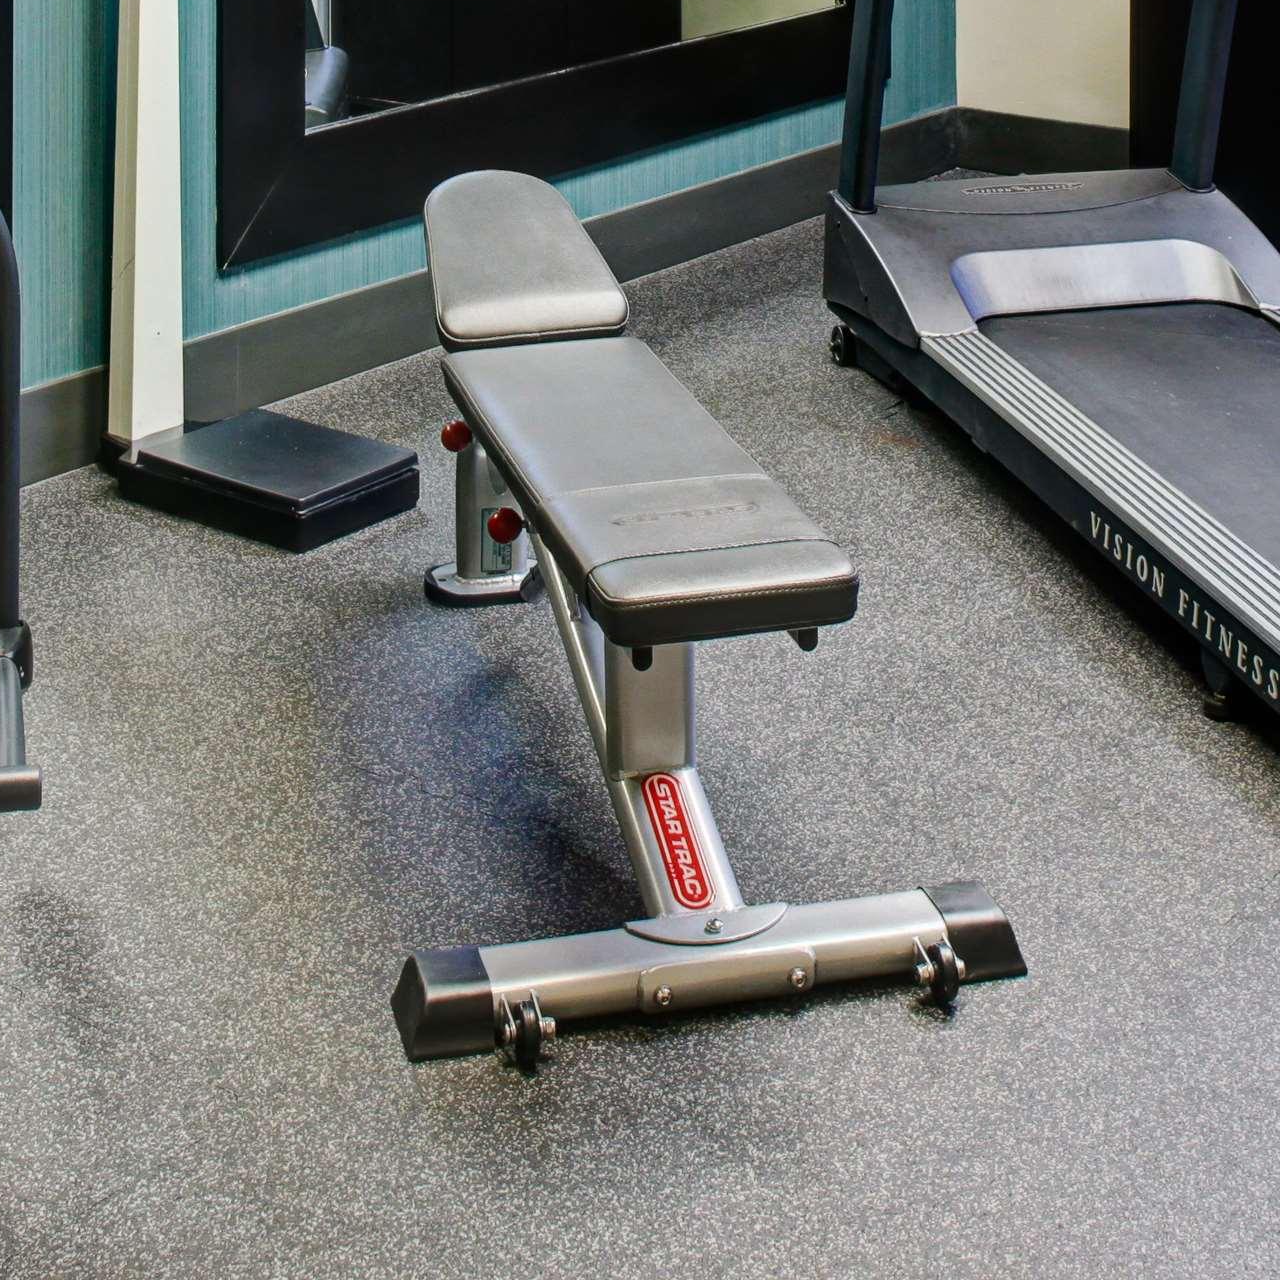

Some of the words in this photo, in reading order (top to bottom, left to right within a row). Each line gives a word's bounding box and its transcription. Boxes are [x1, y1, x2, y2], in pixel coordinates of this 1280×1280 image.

[1090, 511, 1165, 598] VISION
[1177, 588, 1280, 700] FITNESS
[654, 781, 683, 834] STAR
[671, 836, 703, 897] TRAC
